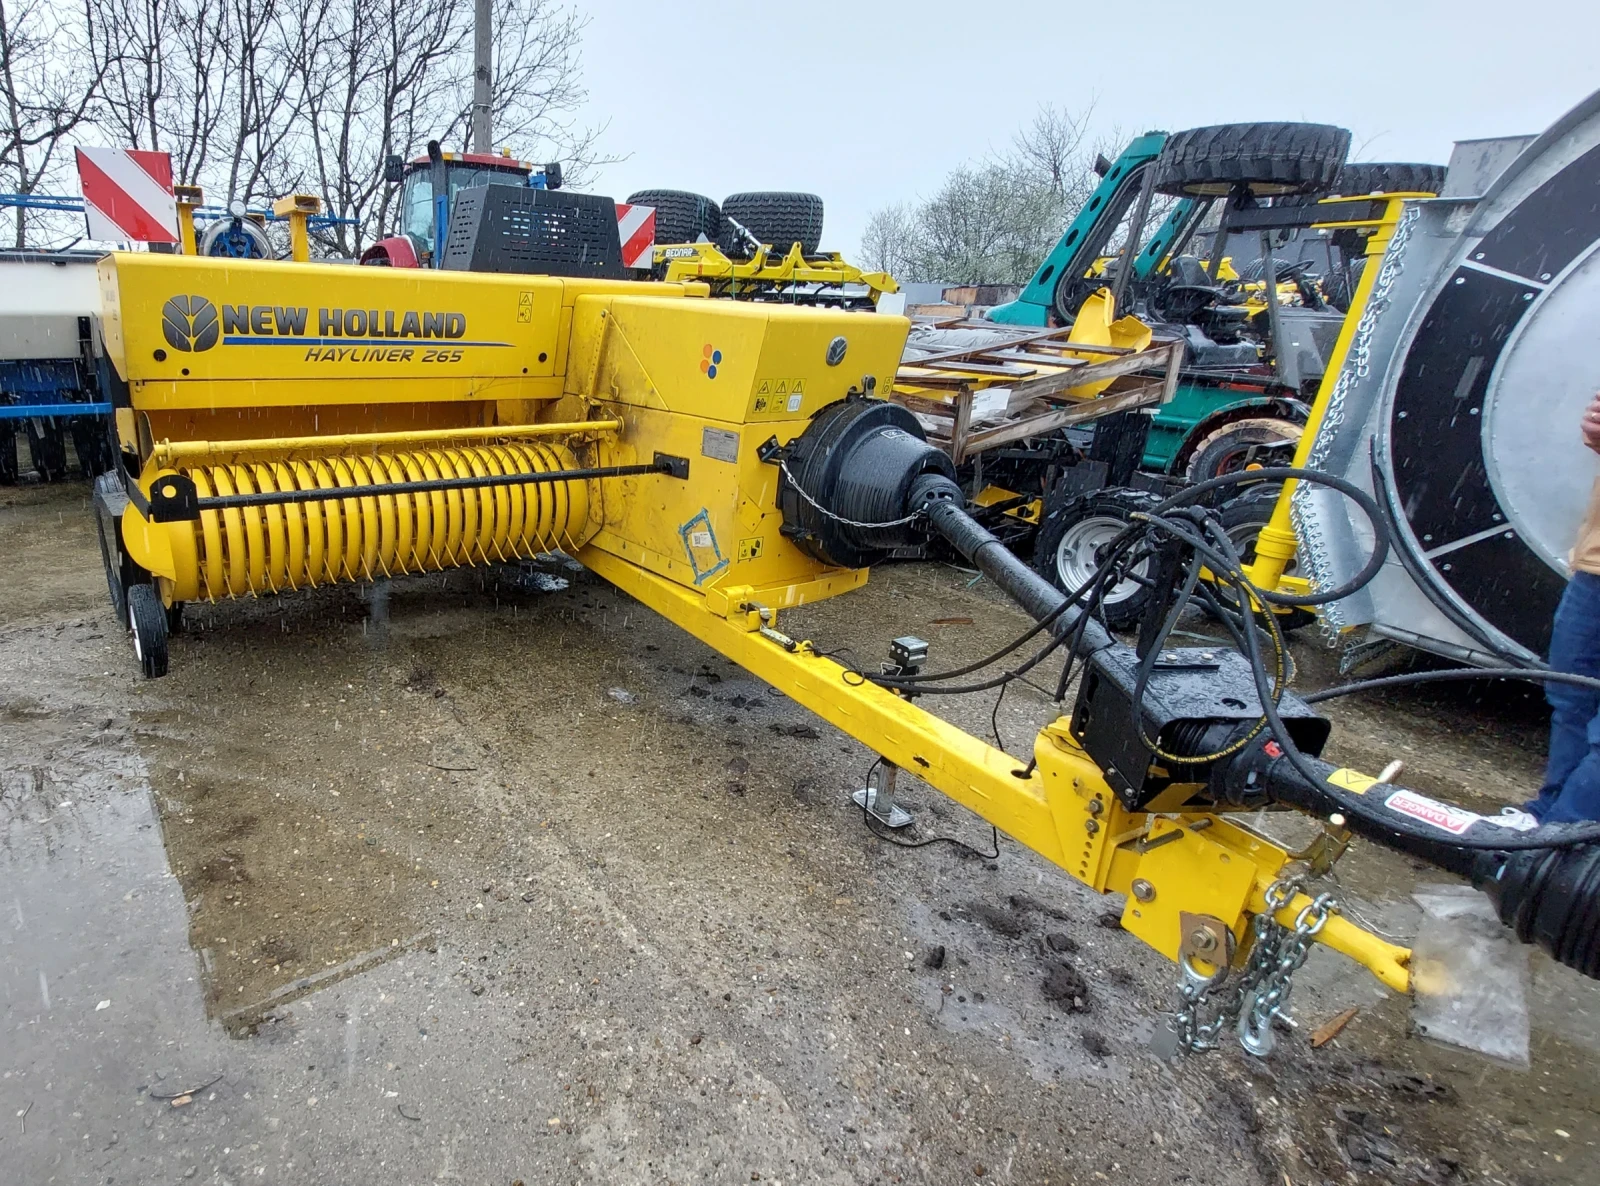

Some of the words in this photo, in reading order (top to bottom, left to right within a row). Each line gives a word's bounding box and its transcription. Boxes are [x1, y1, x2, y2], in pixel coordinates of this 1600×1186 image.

[222, 305, 308, 335] NEW
[318, 308, 466, 339] HOLLAND
[304, 348, 415, 363] HAYLINER
[421, 349, 464, 363] 265
[1391, 796, 1447, 822] DANGER
